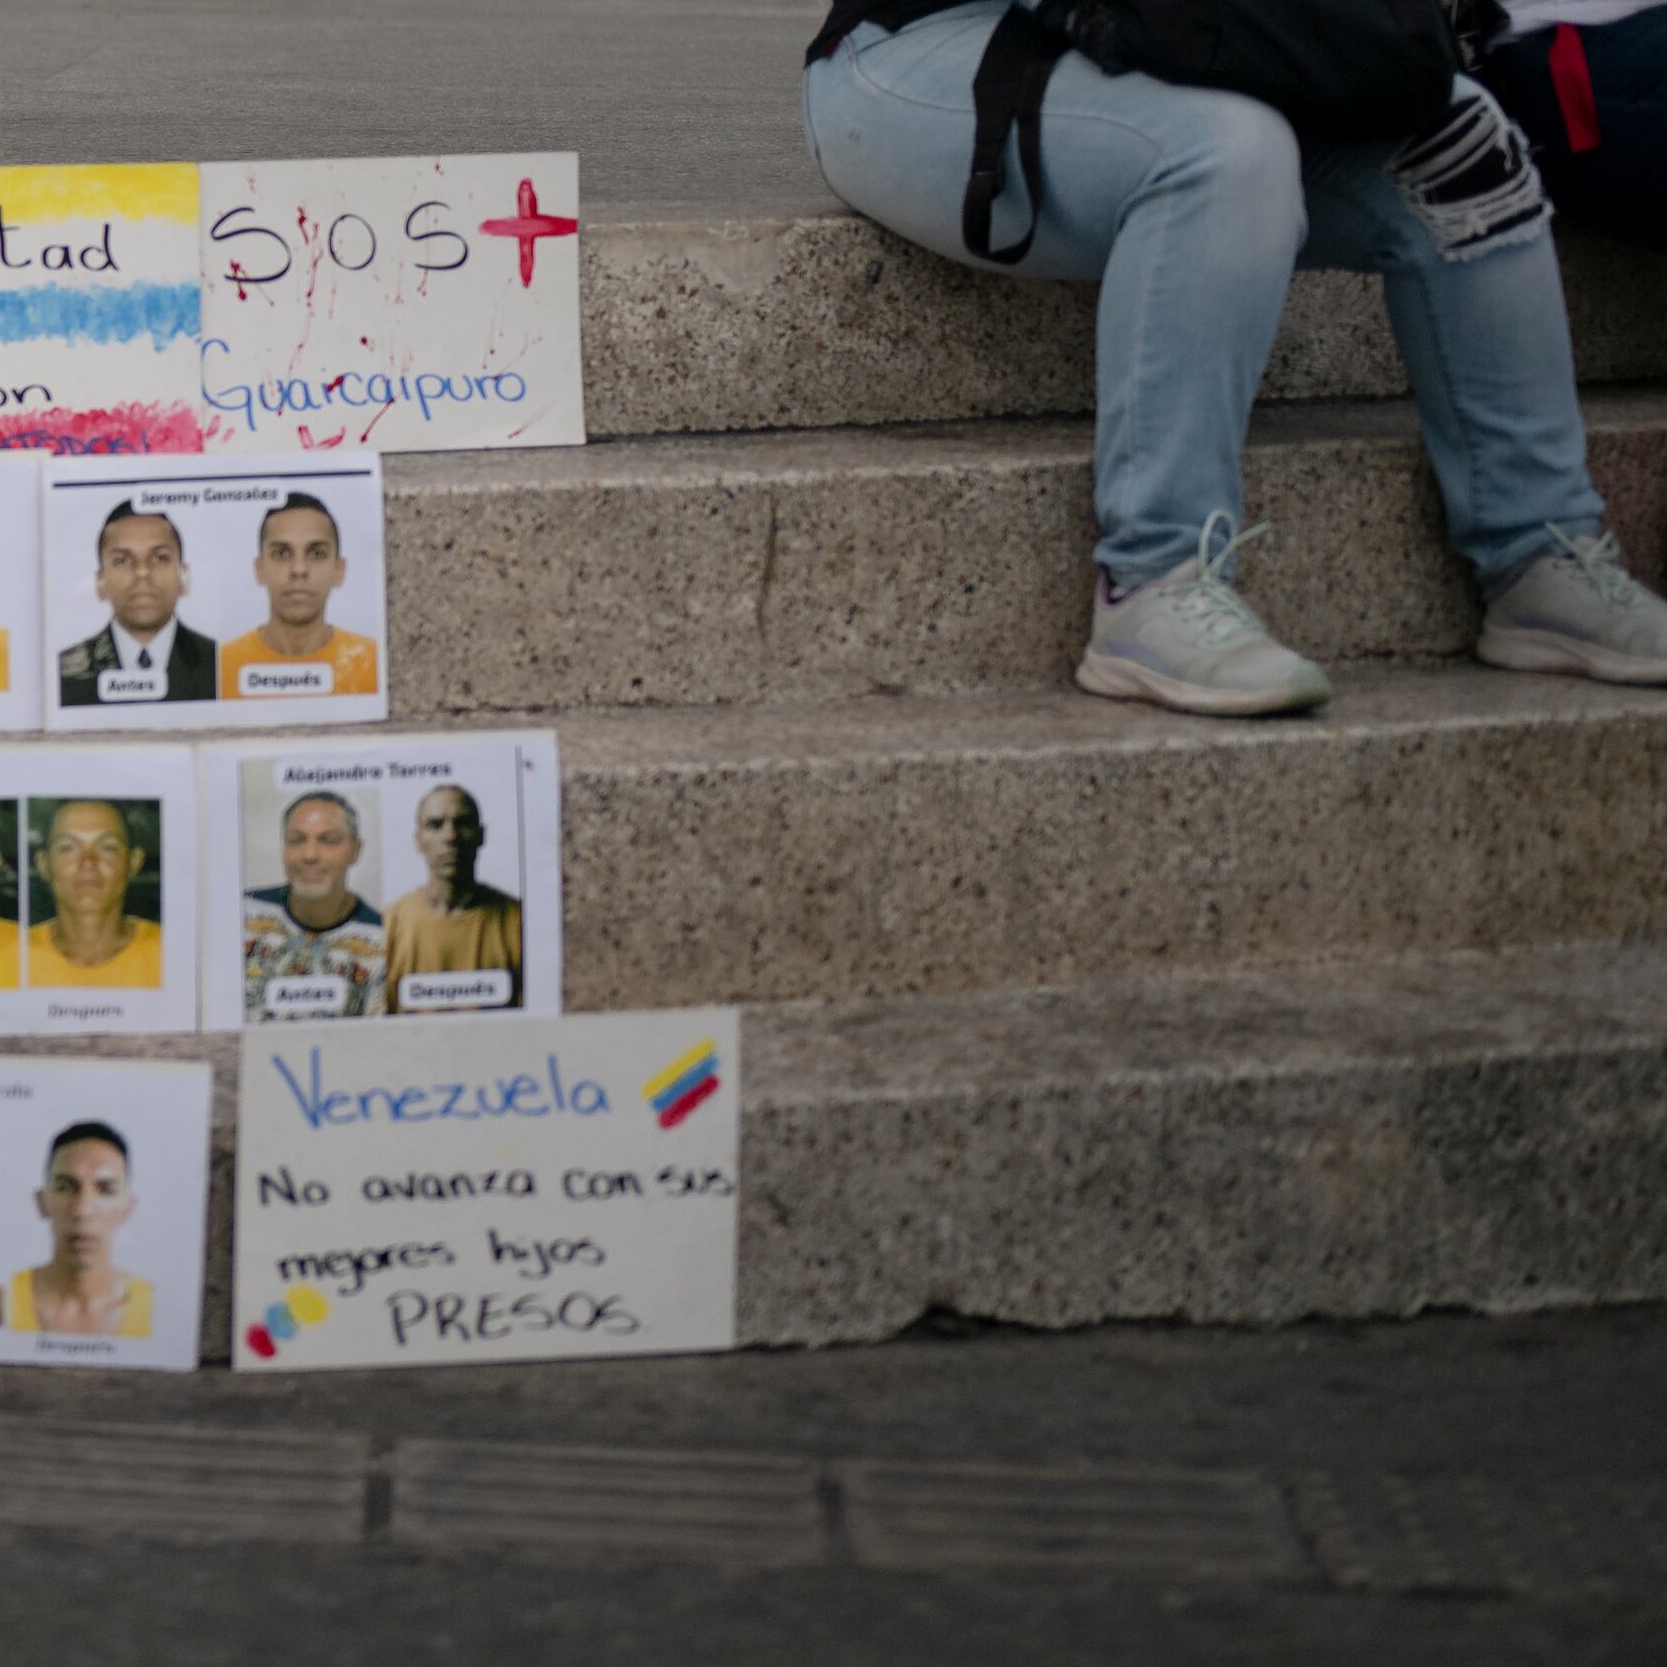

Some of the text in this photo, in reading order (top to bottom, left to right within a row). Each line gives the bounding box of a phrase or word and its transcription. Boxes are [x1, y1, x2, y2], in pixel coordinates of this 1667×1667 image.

[271, 1046, 610, 1131] Venezuela
[258, 1164, 734, 1207] No avanza con sus
[385, 1289, 641, 1347] PRESOS
